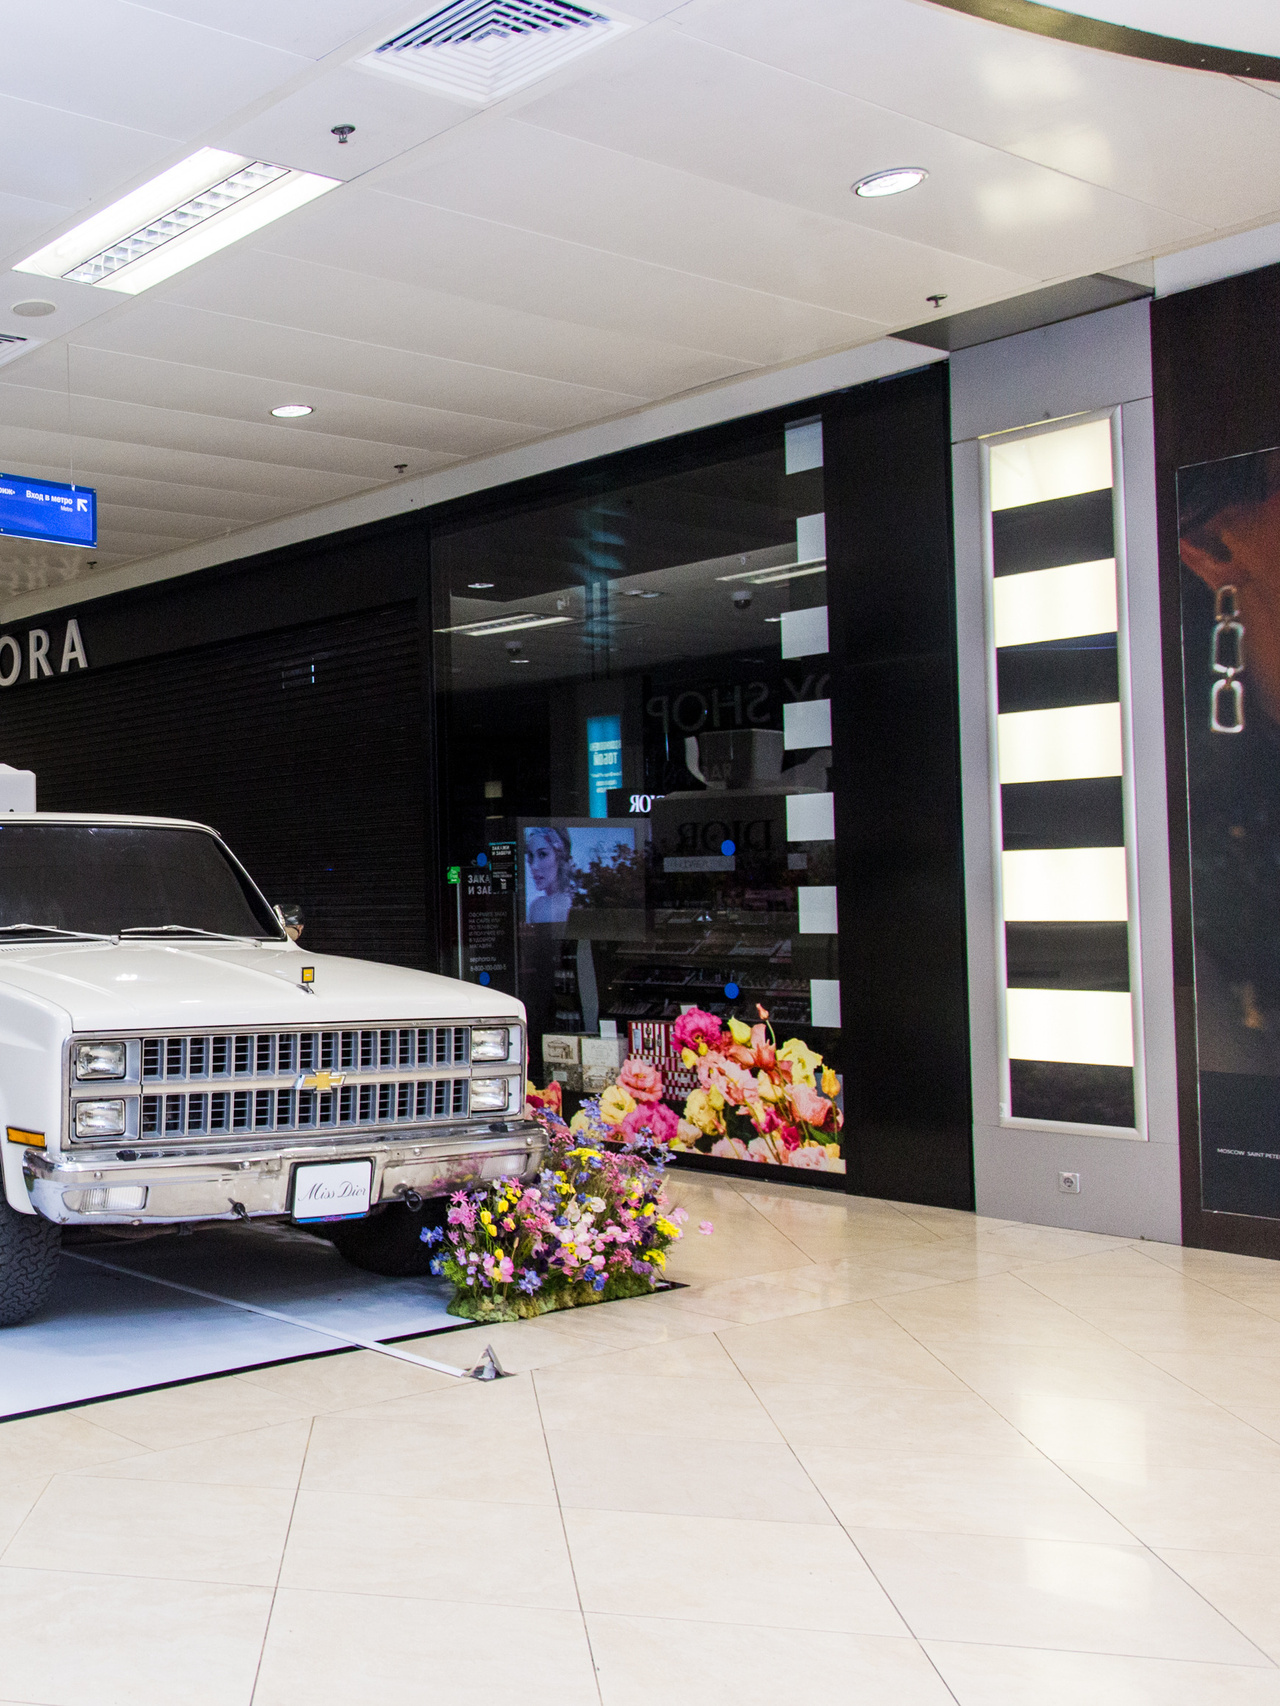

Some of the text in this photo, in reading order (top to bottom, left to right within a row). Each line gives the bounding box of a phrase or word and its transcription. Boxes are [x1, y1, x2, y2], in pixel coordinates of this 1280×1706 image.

[26, 490, 44, 502] Вход
[51, 496, 73, 505] метро
[1217, 1148, 1245, 1156] MOSCOW
[297, 1181, 366, 1202] Miss Dior
